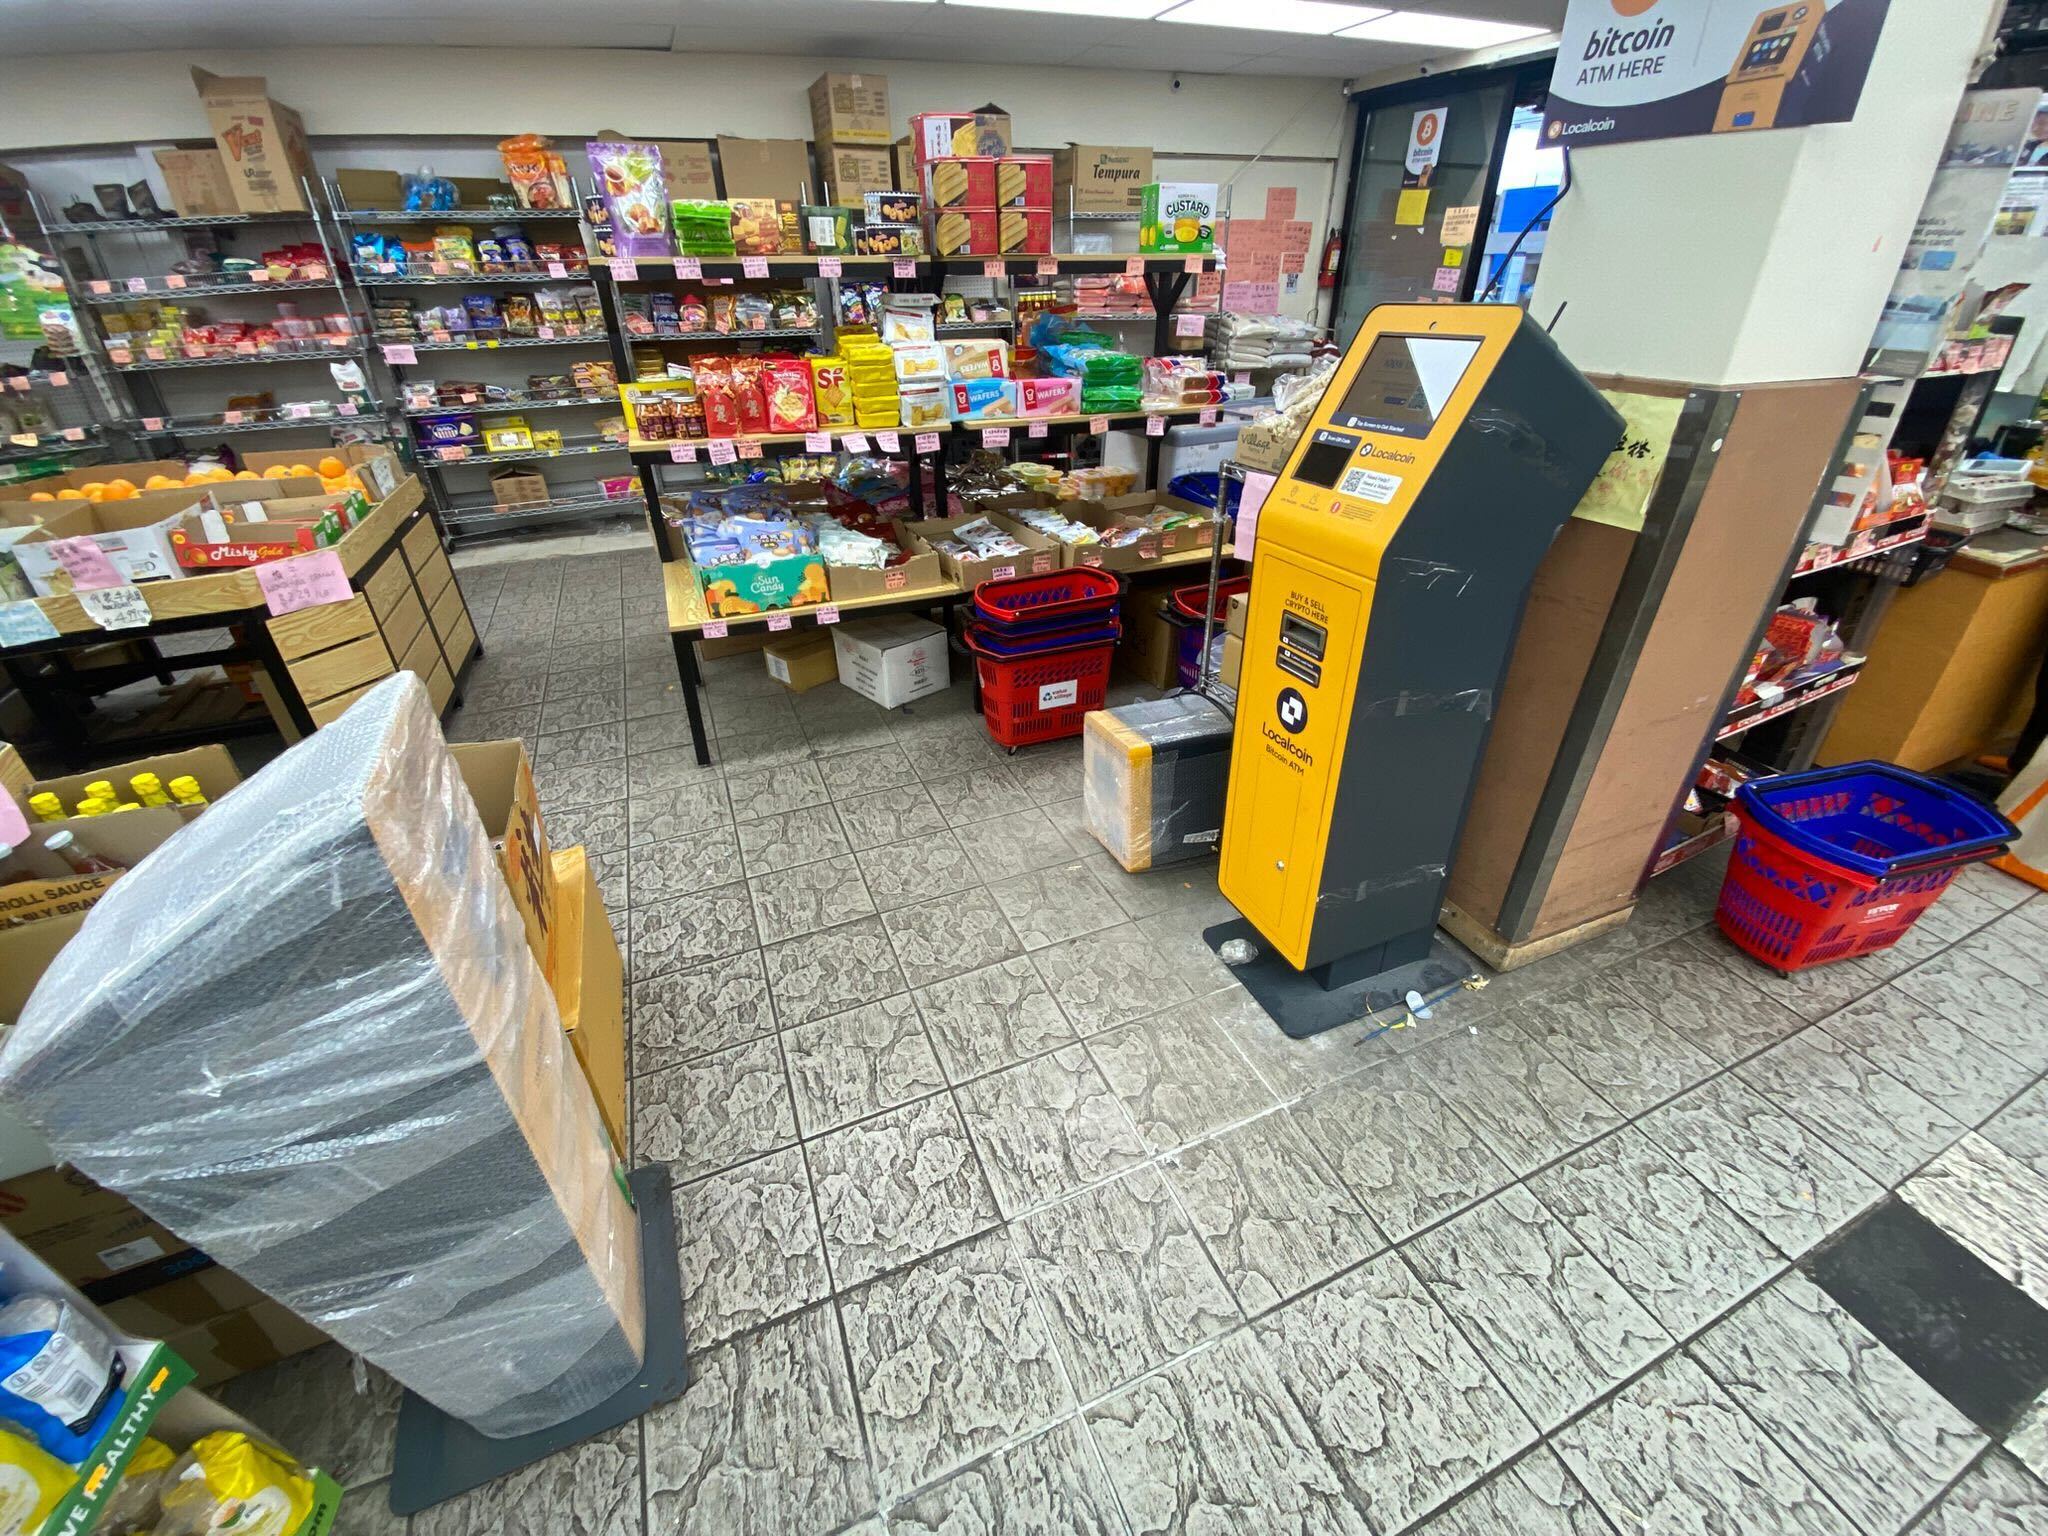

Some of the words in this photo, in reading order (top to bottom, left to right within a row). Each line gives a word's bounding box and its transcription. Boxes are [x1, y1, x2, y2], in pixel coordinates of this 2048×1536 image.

[1583, 18, 1675, 61] bitcoin
[1577, 62, 1615, 86] ATM
[1618, 56, 1666, 79] HERE
[1562, 118, 1614, 135] Localcoin
[1093, 164, 1140, 182] Tempura
[1166, 200, 1209, 216] CUSTARD
[970, 390, 1000, 402] WAFERS
[1037, 387, 1066, 399] WAFERS
[1371, 446, 1416, 464] Localcoin
[211, 546, 259, 561] Misky
[258, 546, 284, 556] Gold
[750, 582, 784, 594] Candy
[758, 576, 779, 585] Sun
[1290, 590, 1303, 601] BUY
[1305, 597, 1309, 605] &
[1310, 599, 1325, 613] SELL
[1285, 598, 1310, 615] CRYPTO
[1311, 610, 1329, 624] HERE
[1262, 721, 1313, 767] Localcoin
[1266, 743, 1288, 764] Bitcoin
[1289, 761, 1304, 776] ATM
[44, 877, 105, 899] SAUCE
